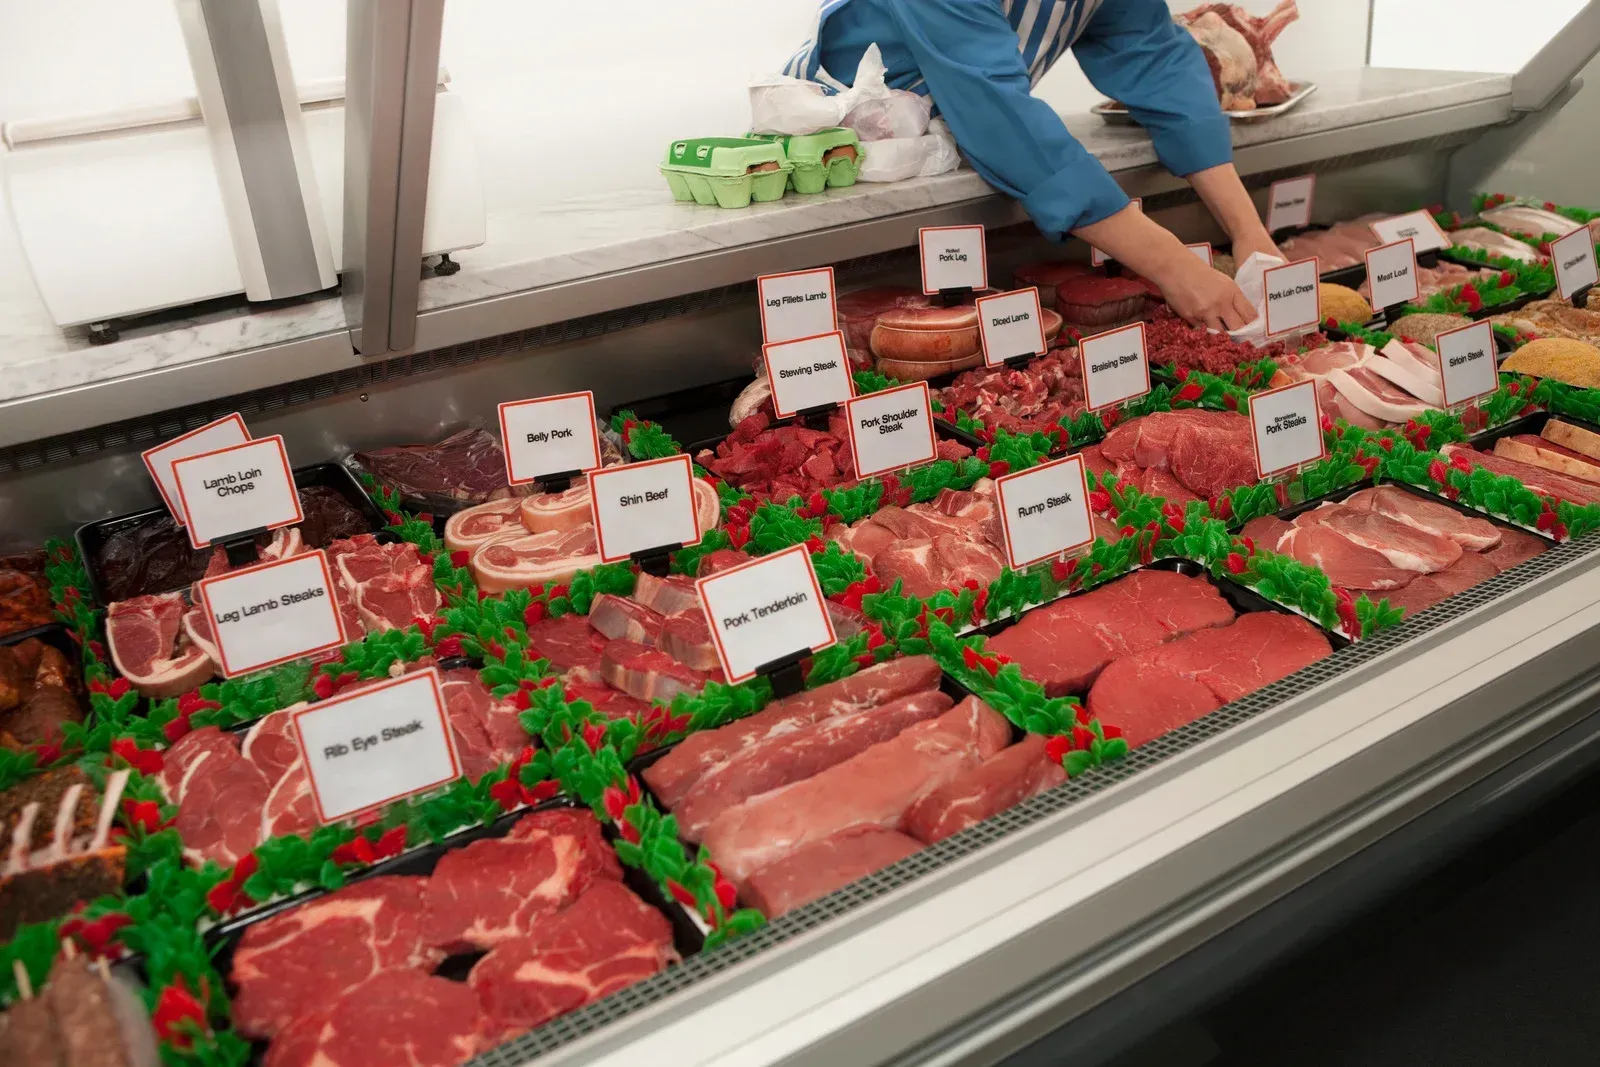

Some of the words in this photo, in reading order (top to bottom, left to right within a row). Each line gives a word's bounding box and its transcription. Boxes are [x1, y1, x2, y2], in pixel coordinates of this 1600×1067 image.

[939, 254, 954, 262] Pork
[955, 253, 968, 262] Leg
[1377, 272, 1393, 283] Meat
[1394, 266, 1408, 278] Loaf
[766, 299, 781, 307] Leg
[782, 295, 804, 304] Fillets
[805, 291, 827, 301] Lamb
[1269, 291, 1282, 301] Pork
[1283, 288, 1295, 298] Loin
[1295, 284, 1314, 294] Chops
[992, 316, 1011, 327] Diced
[1011, 312, 1030, 323] Lamb
[1091, 359, 1119, 374] Braising
[1119, 352, 1139, 365] Steak
[1449, 355, 1467, 367] Sirloin
[1467, 349, 1485, 361] Steak
[779, 366, 813, 379] Stewing
[813, 359, 838, 372] Steak
[861, 417, 881, 430] Pork
[881, 408, 919, 424] Shoulder
[879, 421, 904, 435] Steak
[1265, 422, 1283, 436] Pork
[1283, 416, 1307, 430] Steaks
[526, 431, 550, 444] Belly
[550, 427, 573, 440] Pork
[203, 473, 237, 490] Lamb
[237, 468, 263, 482] Loin
[217, 481, 255, 498] Chops
[619, 493, 644, 508] Shin
[644, 487, 669, 503] Beef
[1017, 500, 1046, 519] Rump
[1046, 492, 1072, 509] Steak
[215, 610, 241, 624] Leg
[241, 599, 279, 617] Lamb
[280, 587, 325, 606] Steaks
[723, 612, 751, 631] Pork
[750, 592, 808, 619] Tenderloin
[323, 742, 350, 762] Rib
[350, 734, 379, 753] Eye
[380, 719, 424, 742] Steak
